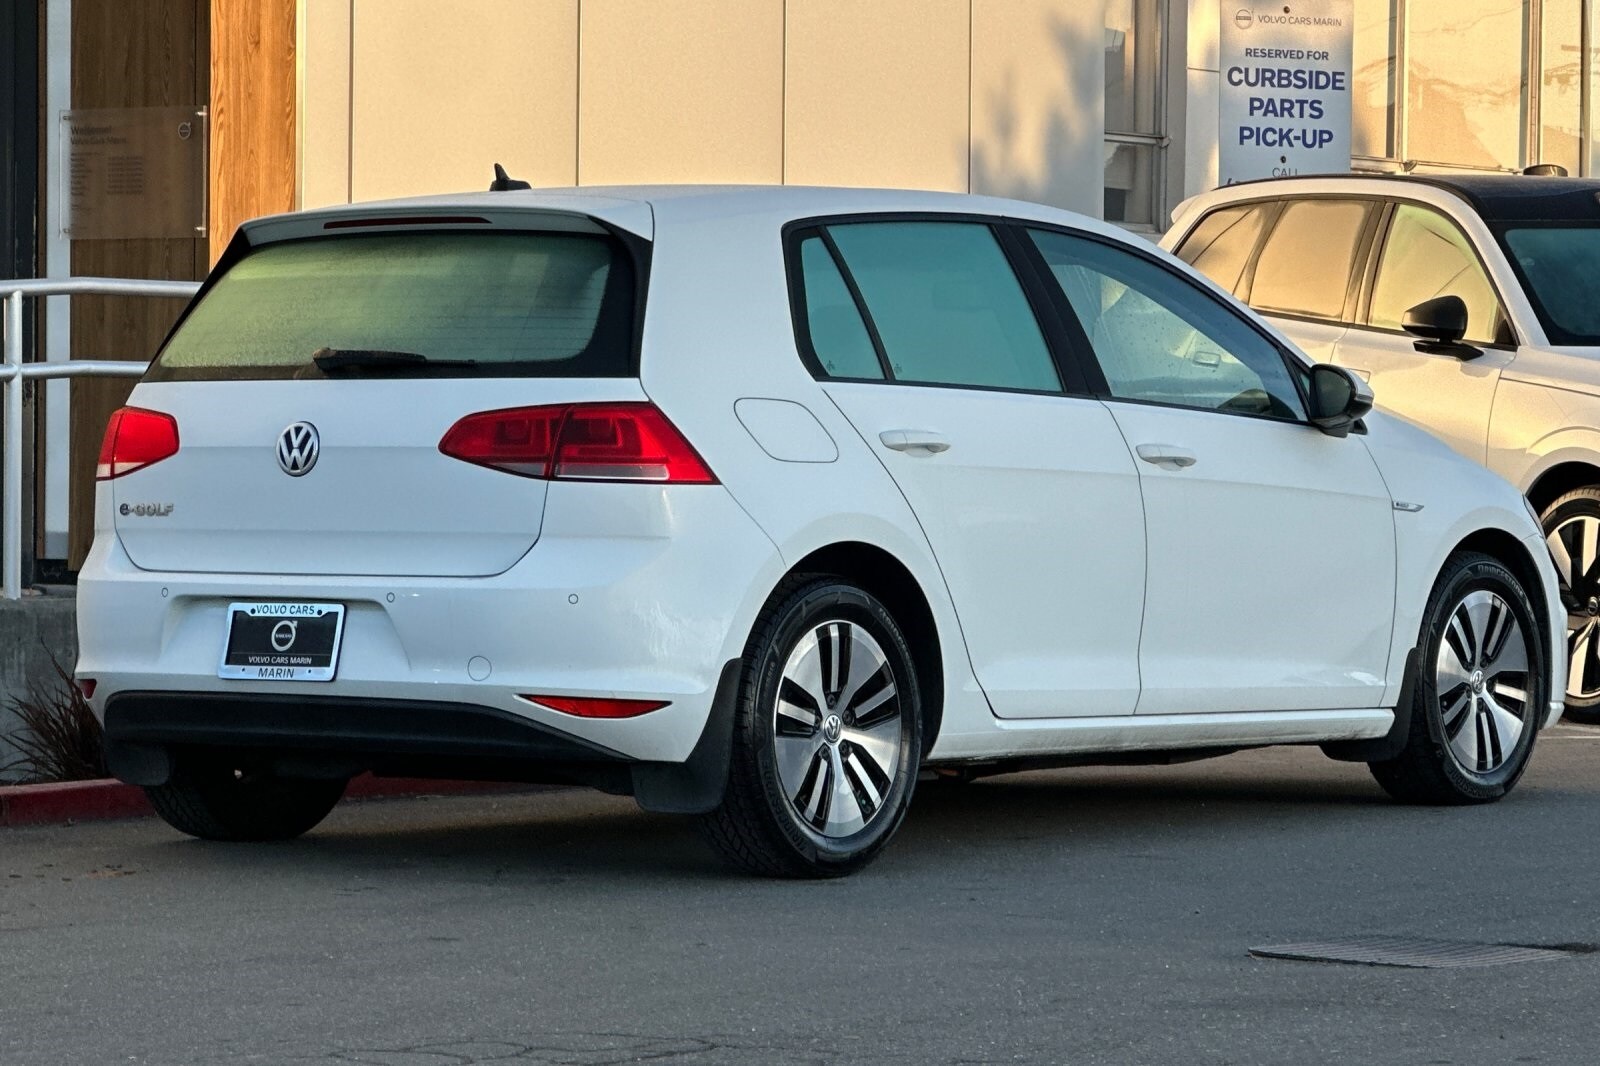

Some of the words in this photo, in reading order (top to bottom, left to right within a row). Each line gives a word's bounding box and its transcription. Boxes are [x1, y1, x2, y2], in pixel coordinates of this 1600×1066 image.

[1258, 15, 1287, 24] VOLVO
[1288, 16, 1312, 25] CARS
[1314, 18, 1342, 27] MARIN
[1245, 48, 1304, 60] RESERVED
[1306, 51, 1329, 61] FOR
[1227, 66, 1346, 91] CURBSIDE
[1249, 97, 1324, 119] PARTS
[1239, 126, 1334, 148] PICK-UP
[256, 604, 287, 615] VOLVO
[289, 605, 315, 615] CARS
[271, 656, 288, 664] CARS
[290, 657, 312, 665] MARIN
[258, 668, 294, 678] MARIN
